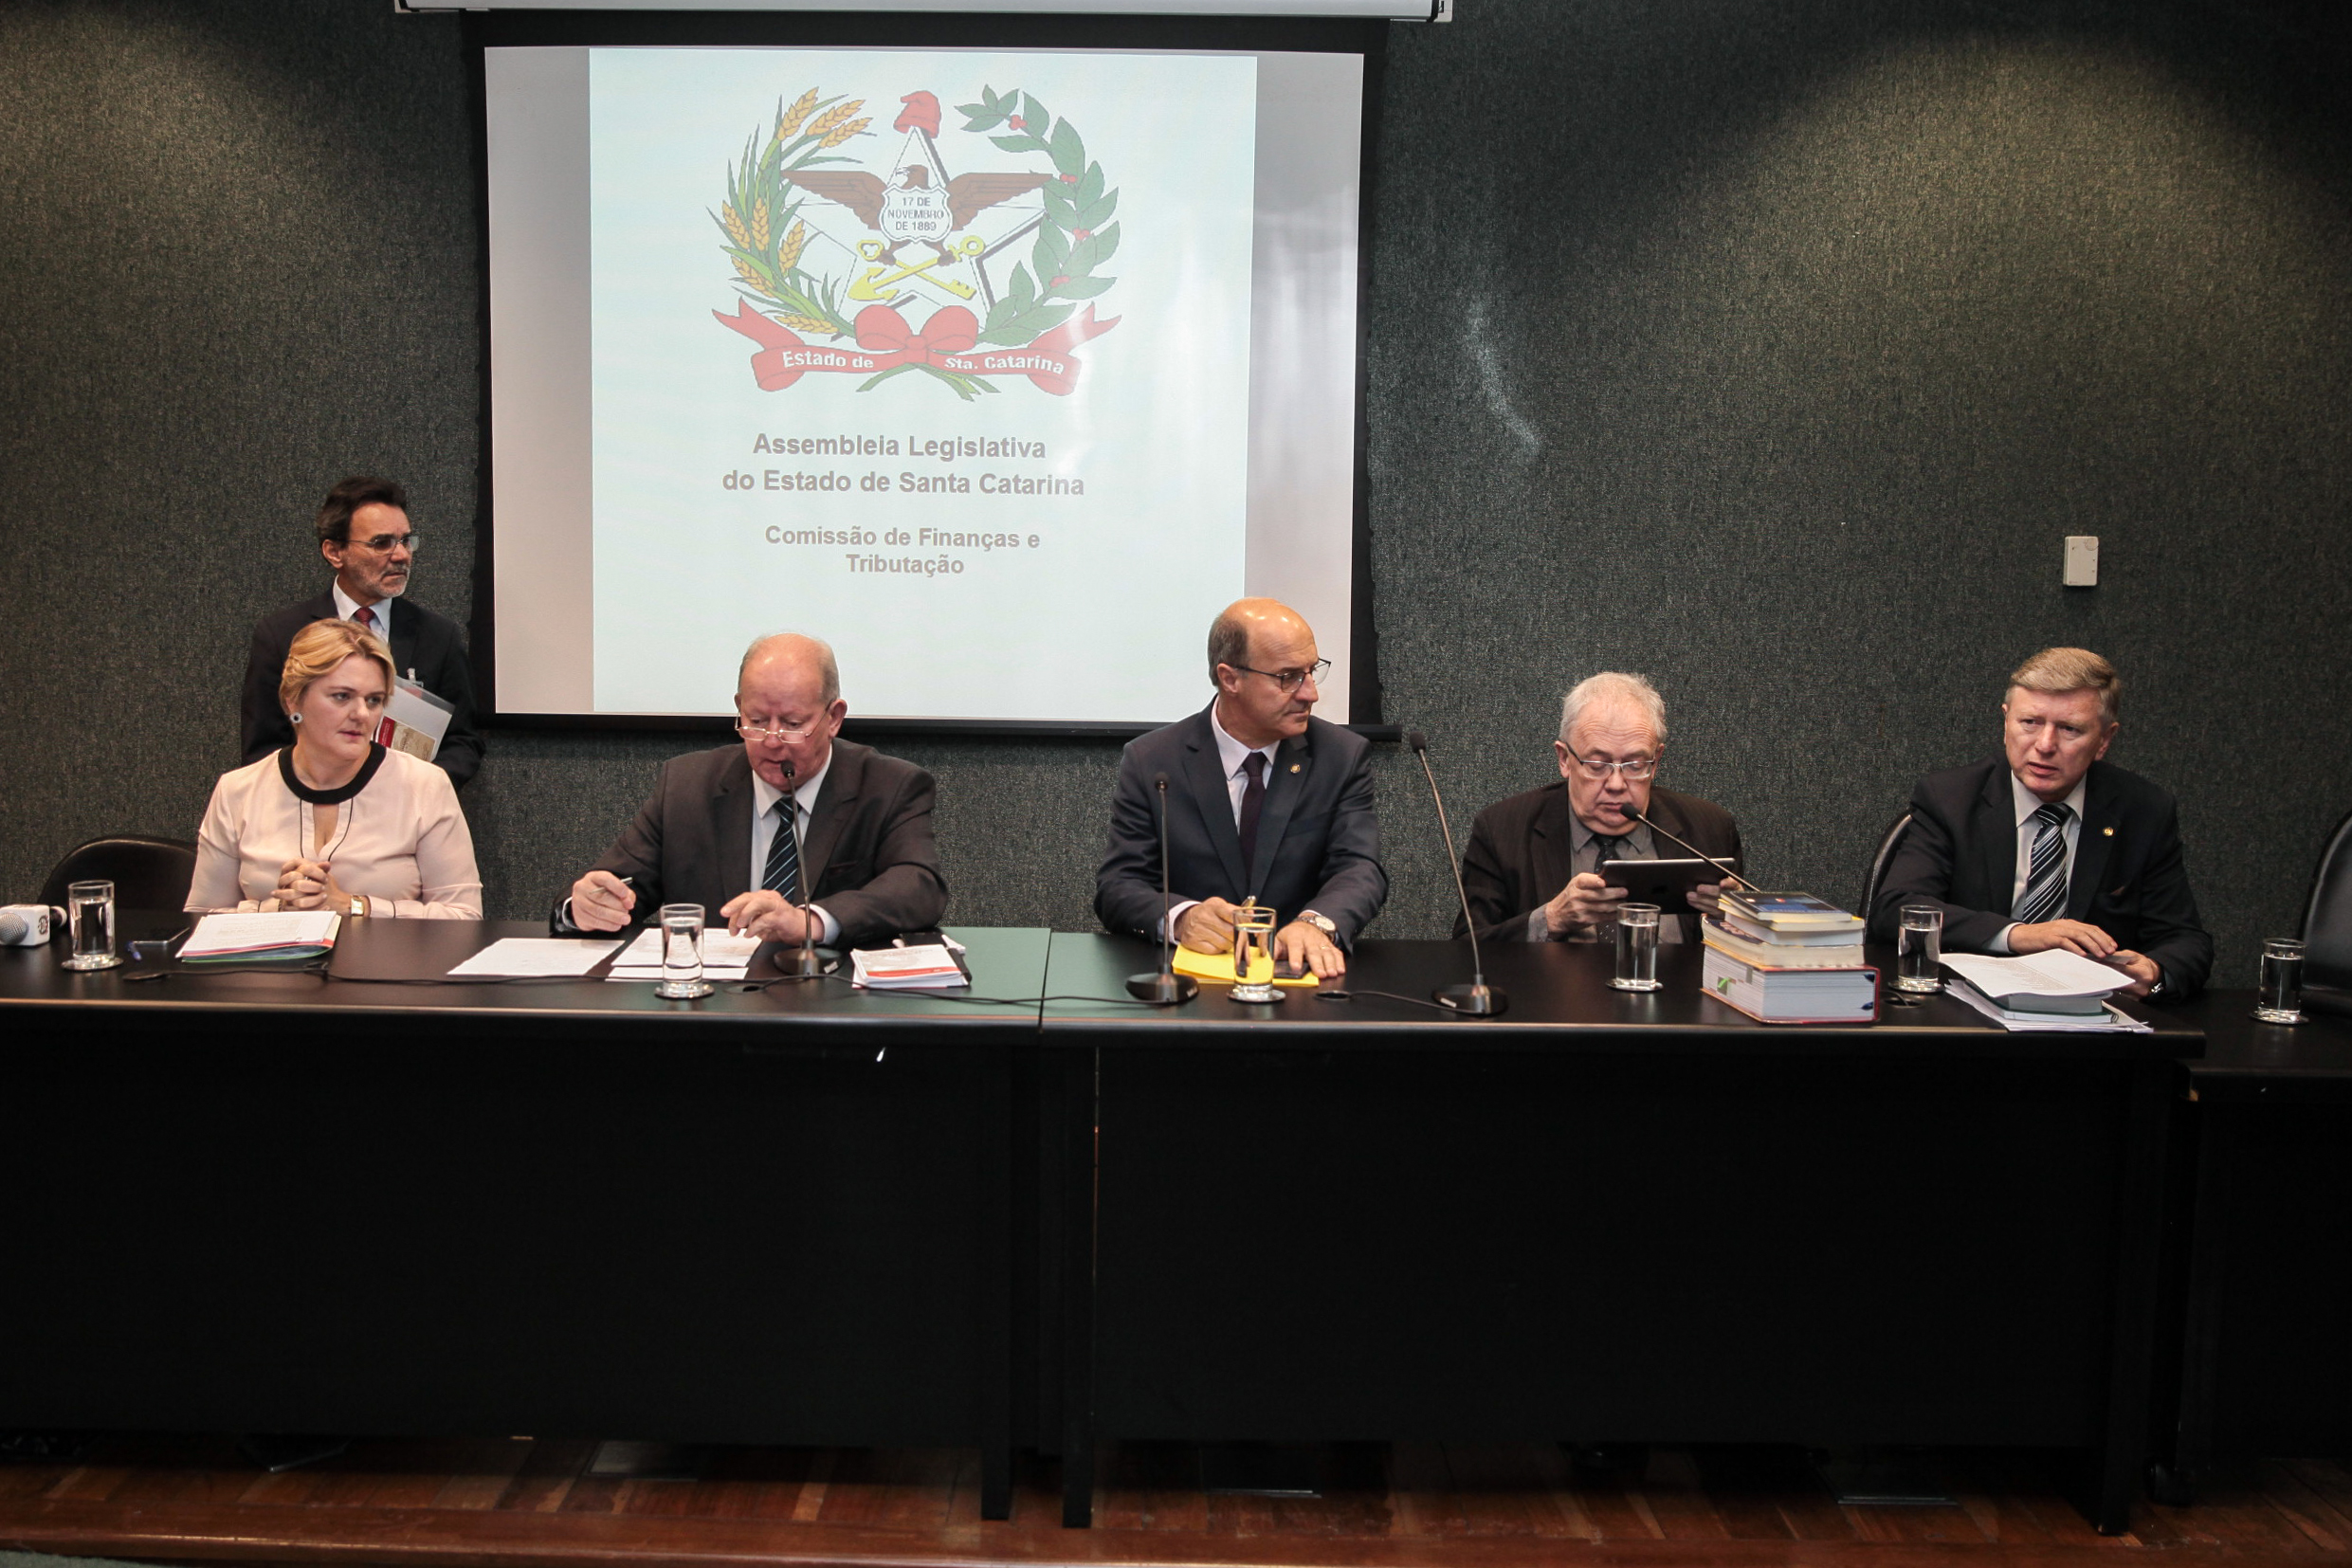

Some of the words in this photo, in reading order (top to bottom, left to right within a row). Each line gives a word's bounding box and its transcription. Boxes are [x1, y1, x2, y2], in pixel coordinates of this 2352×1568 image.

[903, 196, 914, 207] 17
[917, 196, 931, 207] DE
[887, 209, 945, 220] NOVEMBRO
[895, 221, 908, 231] DE
[911, 221, 938, 231] 1889
[782, 350, 847, 368] Estado
[851, 356, 874, 369] de
[944, 357, 978, 370] Sta.
[984, 355, 1065, 374] Catarina
[753, 432, 900, 456] Assembleia
[908, 435, 1047, 463] Legislativa
[722, 469, 756, 490] do
[763, 469, 852, 492] Estado
[860, 471, 891, 492] de
[899, 471, 971, 494] Santa
[979, 473, 1085, 496] Catarina
[765, 525, 877, 547] Comissão
[884, 527, 911, 547] de
[919, 527, 1020, 552] Finanças
[1027, 533, 1041, 549] e
[846, 554, 965, 578] Tributação
